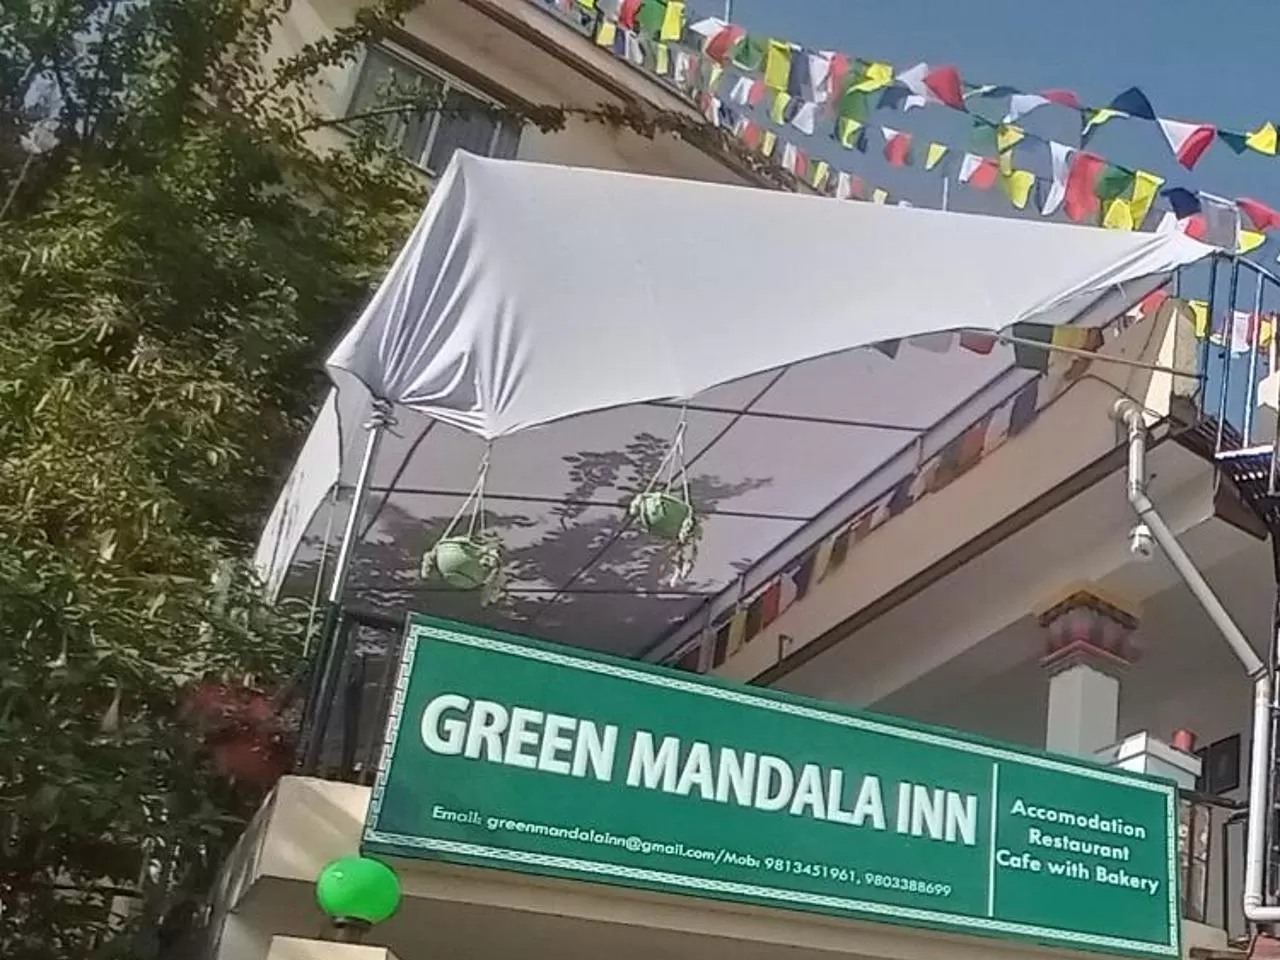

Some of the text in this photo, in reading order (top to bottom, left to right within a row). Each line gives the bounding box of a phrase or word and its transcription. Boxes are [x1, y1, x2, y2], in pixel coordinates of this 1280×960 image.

[420, 694, 978, 846] GREEN MANDALA INN
[1010, 799, 1146, 839] Accomodation
[432, 805, 483, 826] Email:
[764, 856, 862, 886] 9813451961,
[864, 872, 952, 897] 9803388699
[1029, 827, 1130, 861] Restaurant
[996, 849, 1159, 896] Cafe with Bakery
